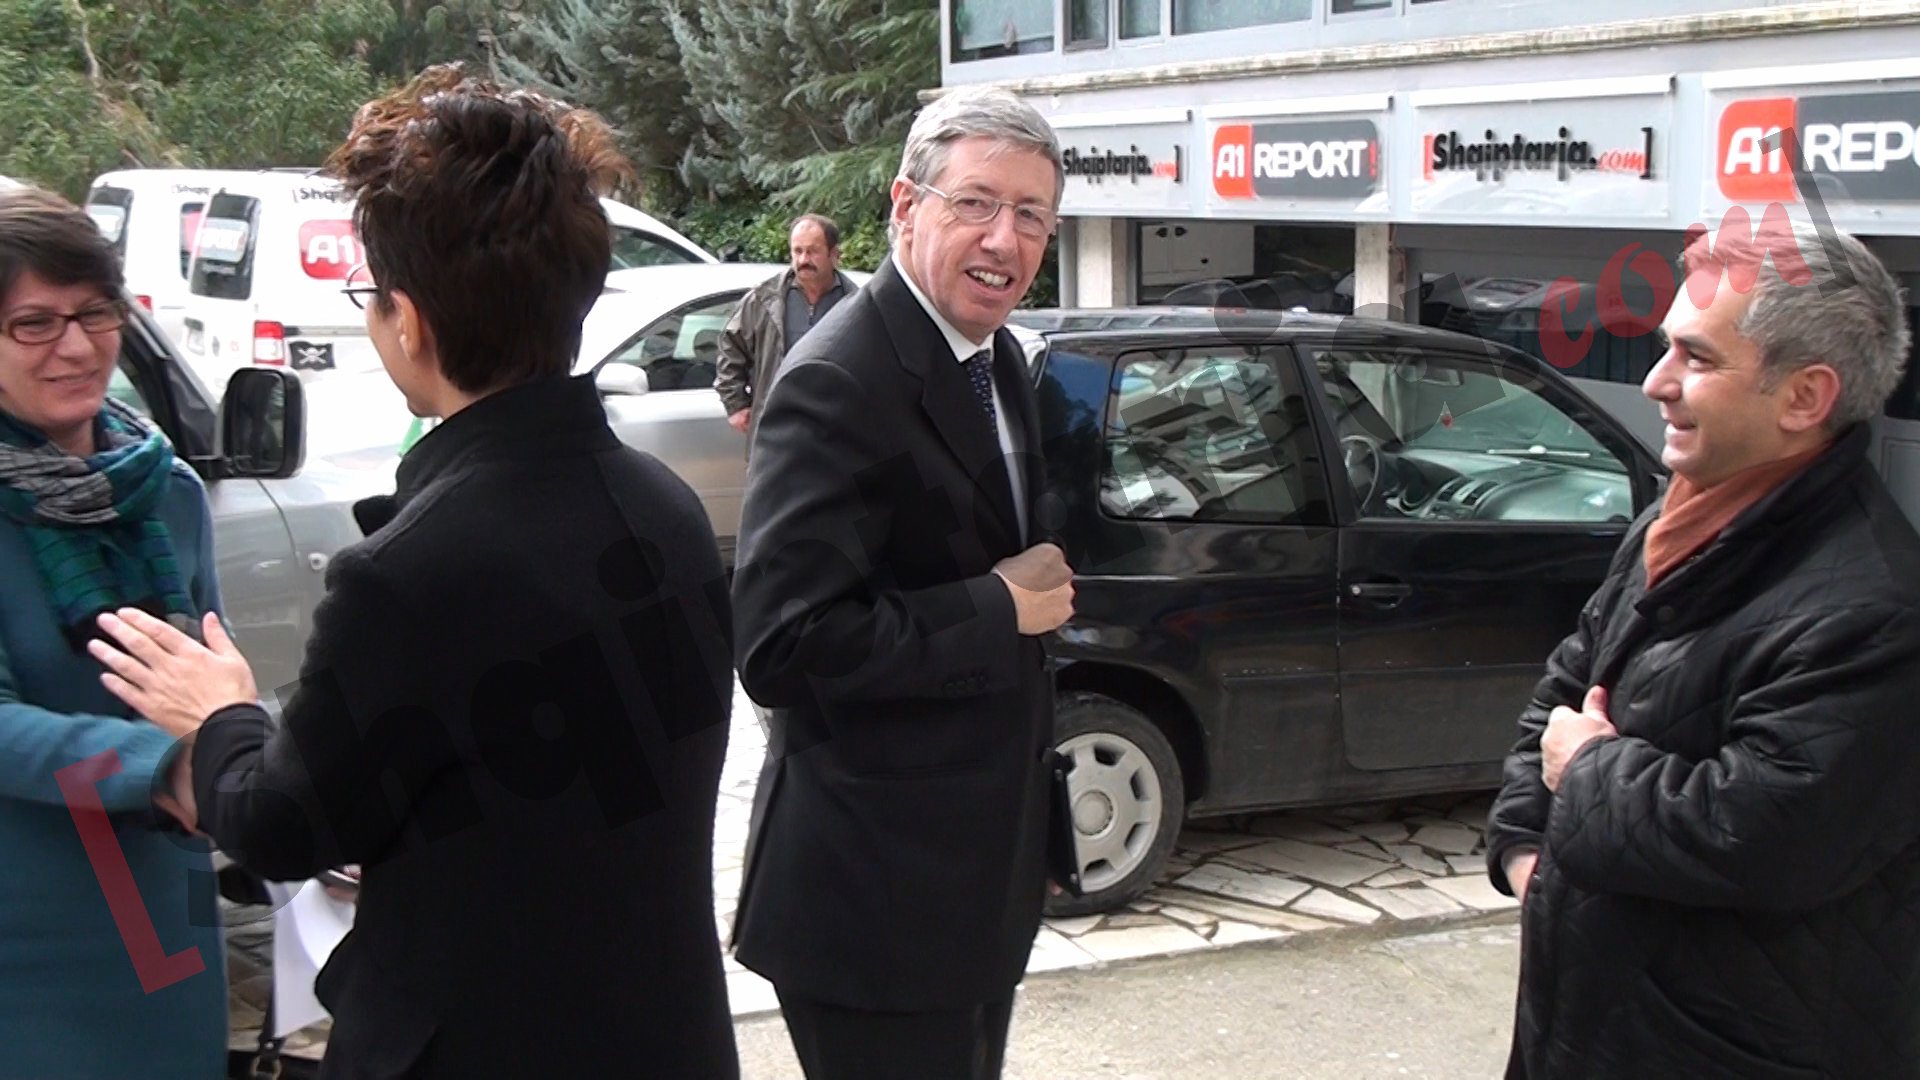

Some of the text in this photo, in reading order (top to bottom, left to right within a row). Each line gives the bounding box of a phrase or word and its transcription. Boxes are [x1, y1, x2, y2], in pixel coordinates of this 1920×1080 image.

[1215, 143, 1246, 179] A1
[1723, 126, 1781, 175] A1
[306, 234, 355, 265] A1
